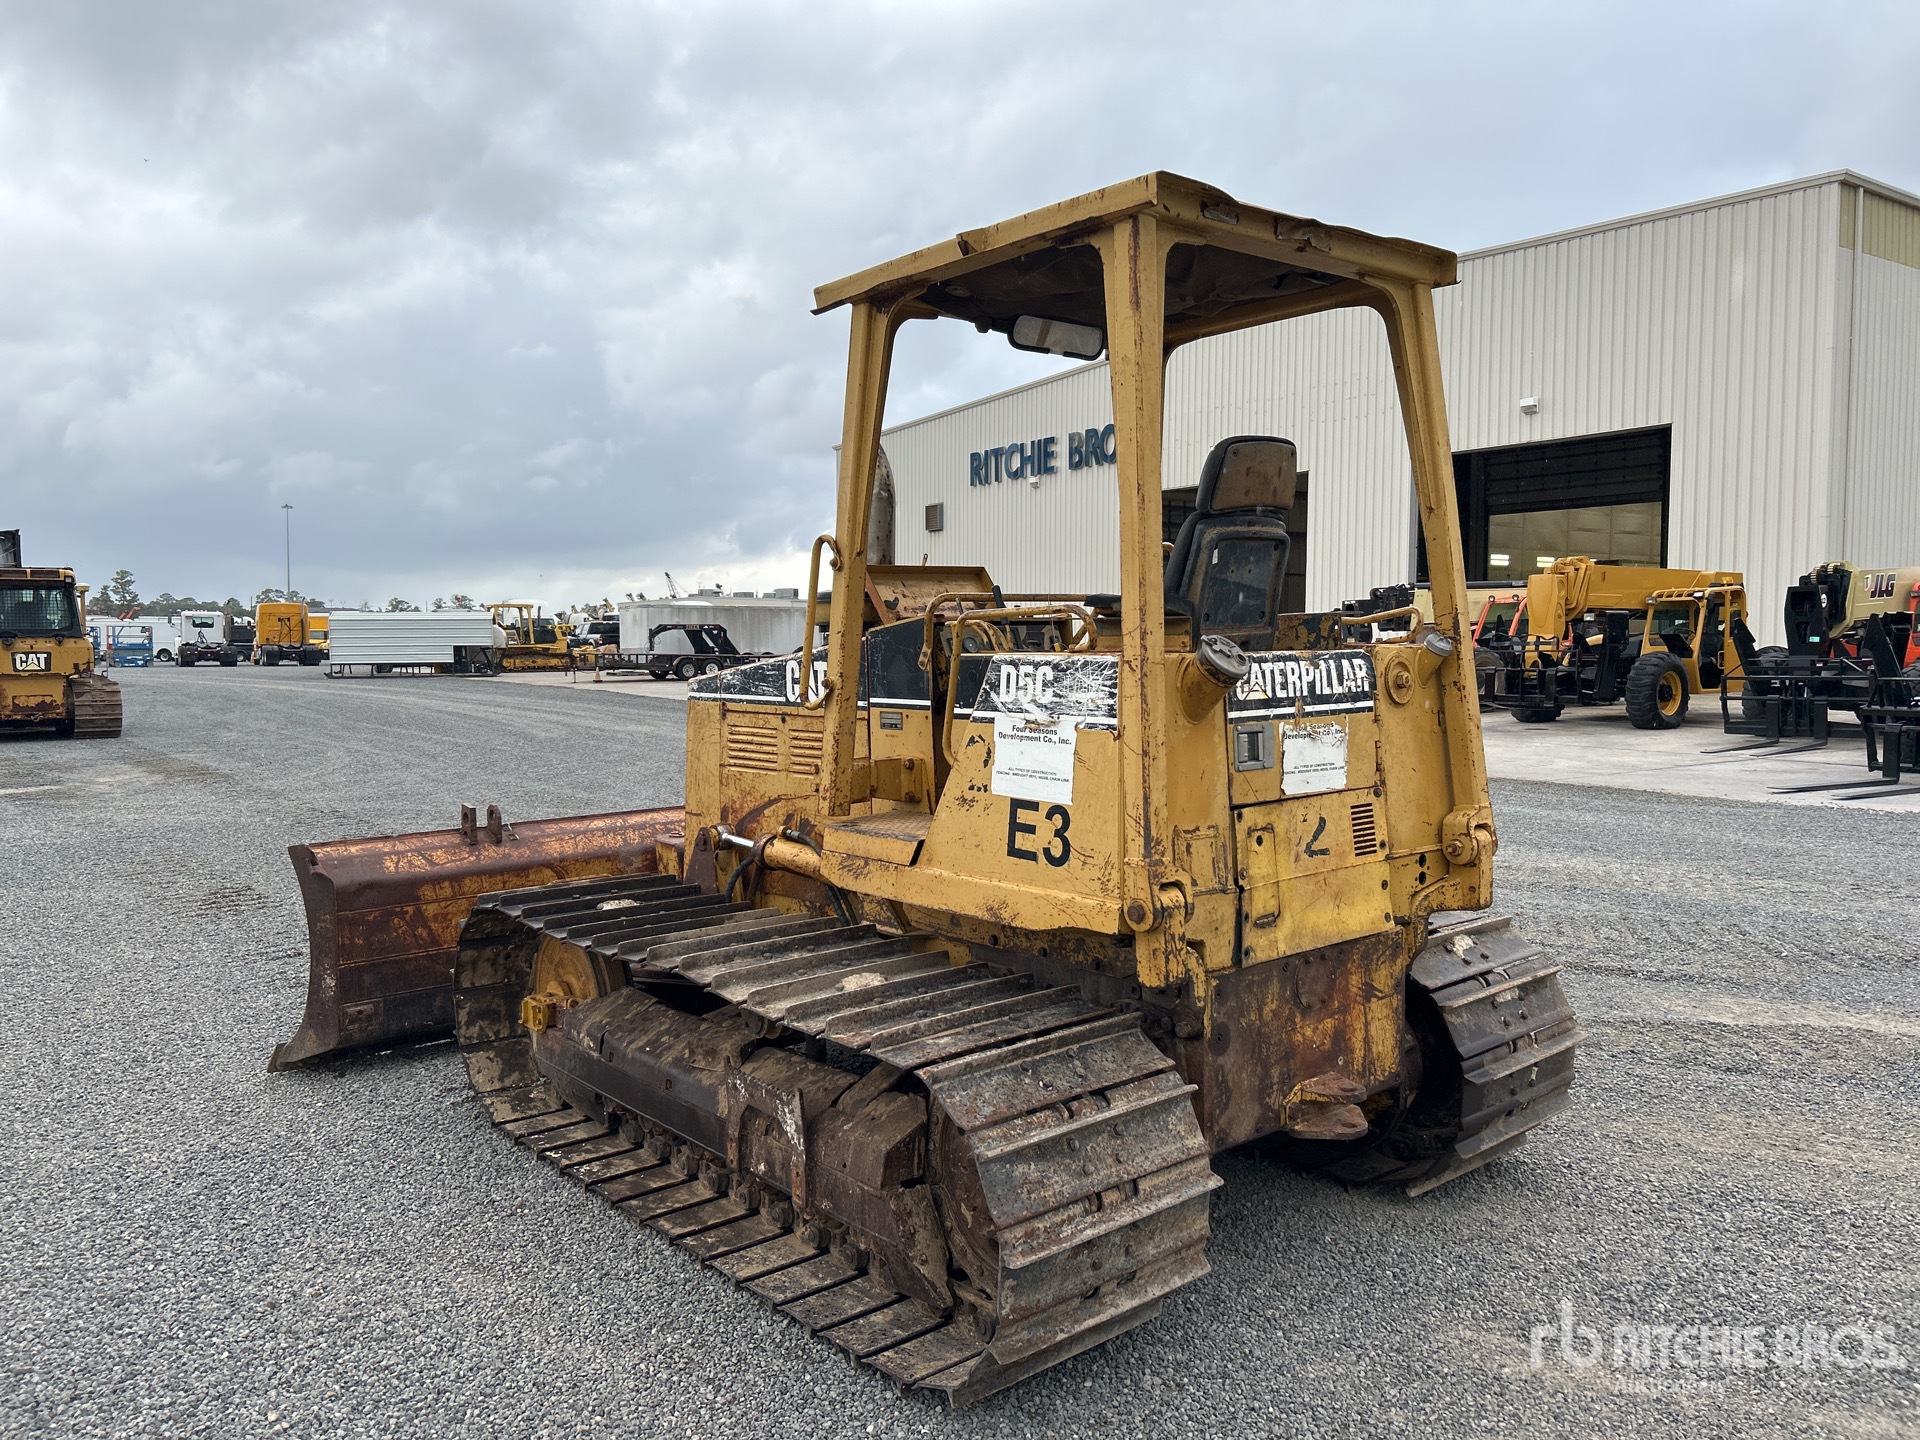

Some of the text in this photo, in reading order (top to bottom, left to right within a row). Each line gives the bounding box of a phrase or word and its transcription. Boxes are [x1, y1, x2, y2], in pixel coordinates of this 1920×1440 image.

[969, 437, 1057, 487] RITCHIE
[1869, 573, 1897, 599] JLG
[15, 653, 47, 671] CAT
[1235, 658, 1370, 701] CATERPILLAR
[1000, 664, 1054, 704] D5C
[998, 731, 1041, 743] Development
[1058, 736, 1072, 746] Inc.
[1007, 798, 1071, 868] E3
